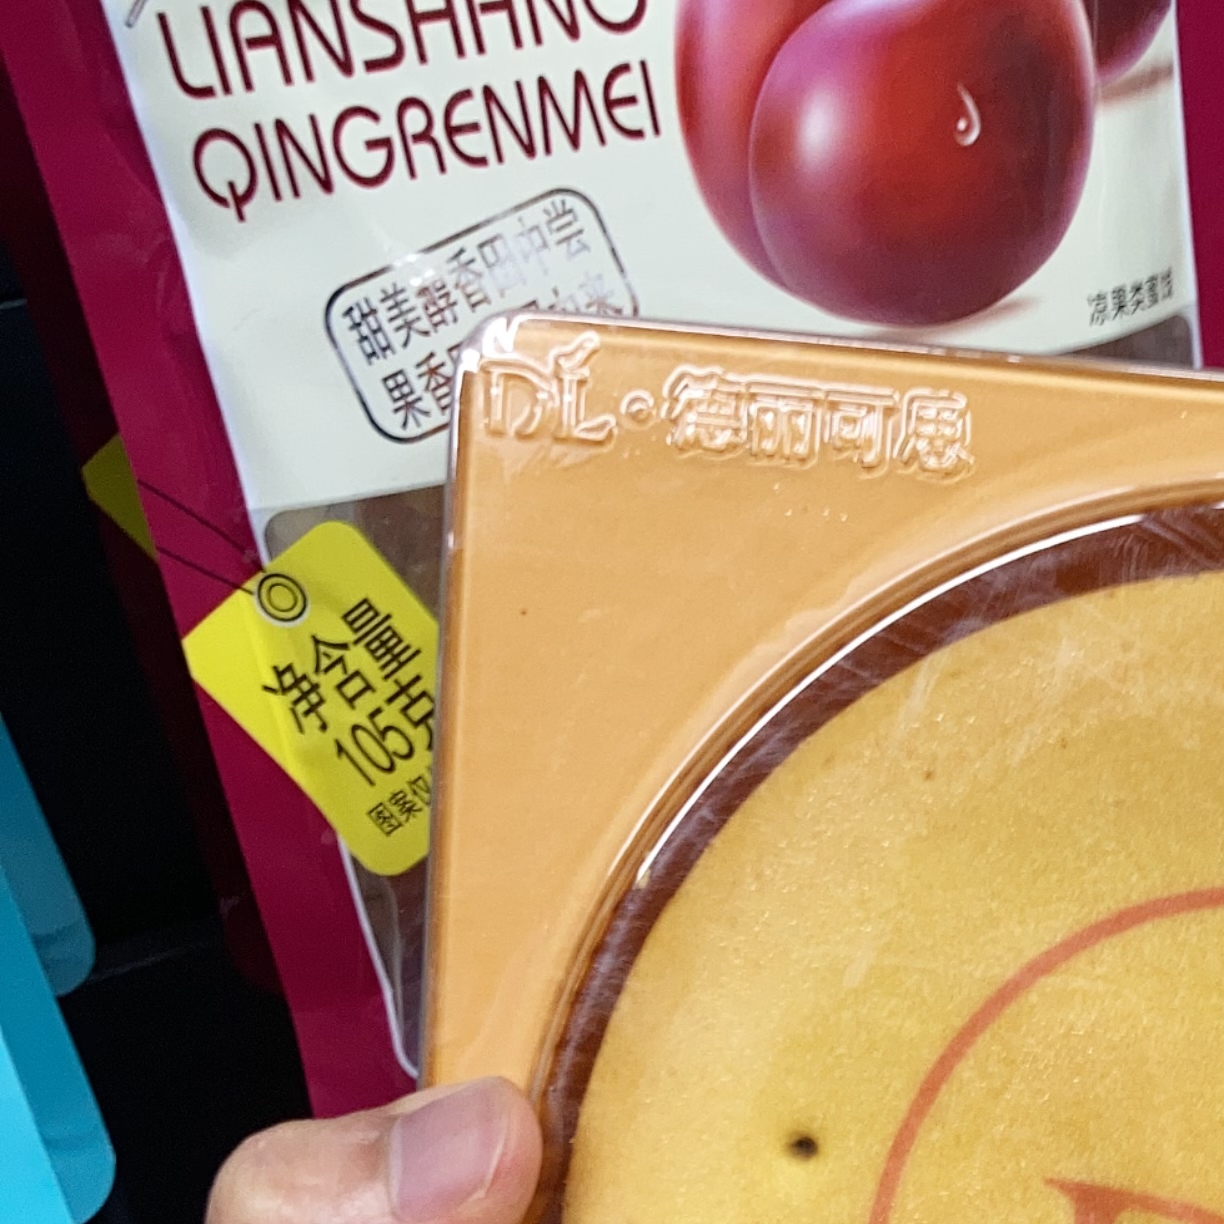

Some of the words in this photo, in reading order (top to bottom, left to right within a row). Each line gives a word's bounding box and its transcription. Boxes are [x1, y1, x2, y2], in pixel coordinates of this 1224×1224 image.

[193, 59, 661, 222] QINGRENMEI
[262, 598, 422, 736] 净含量
[334, 674, 437, 787] 105克
